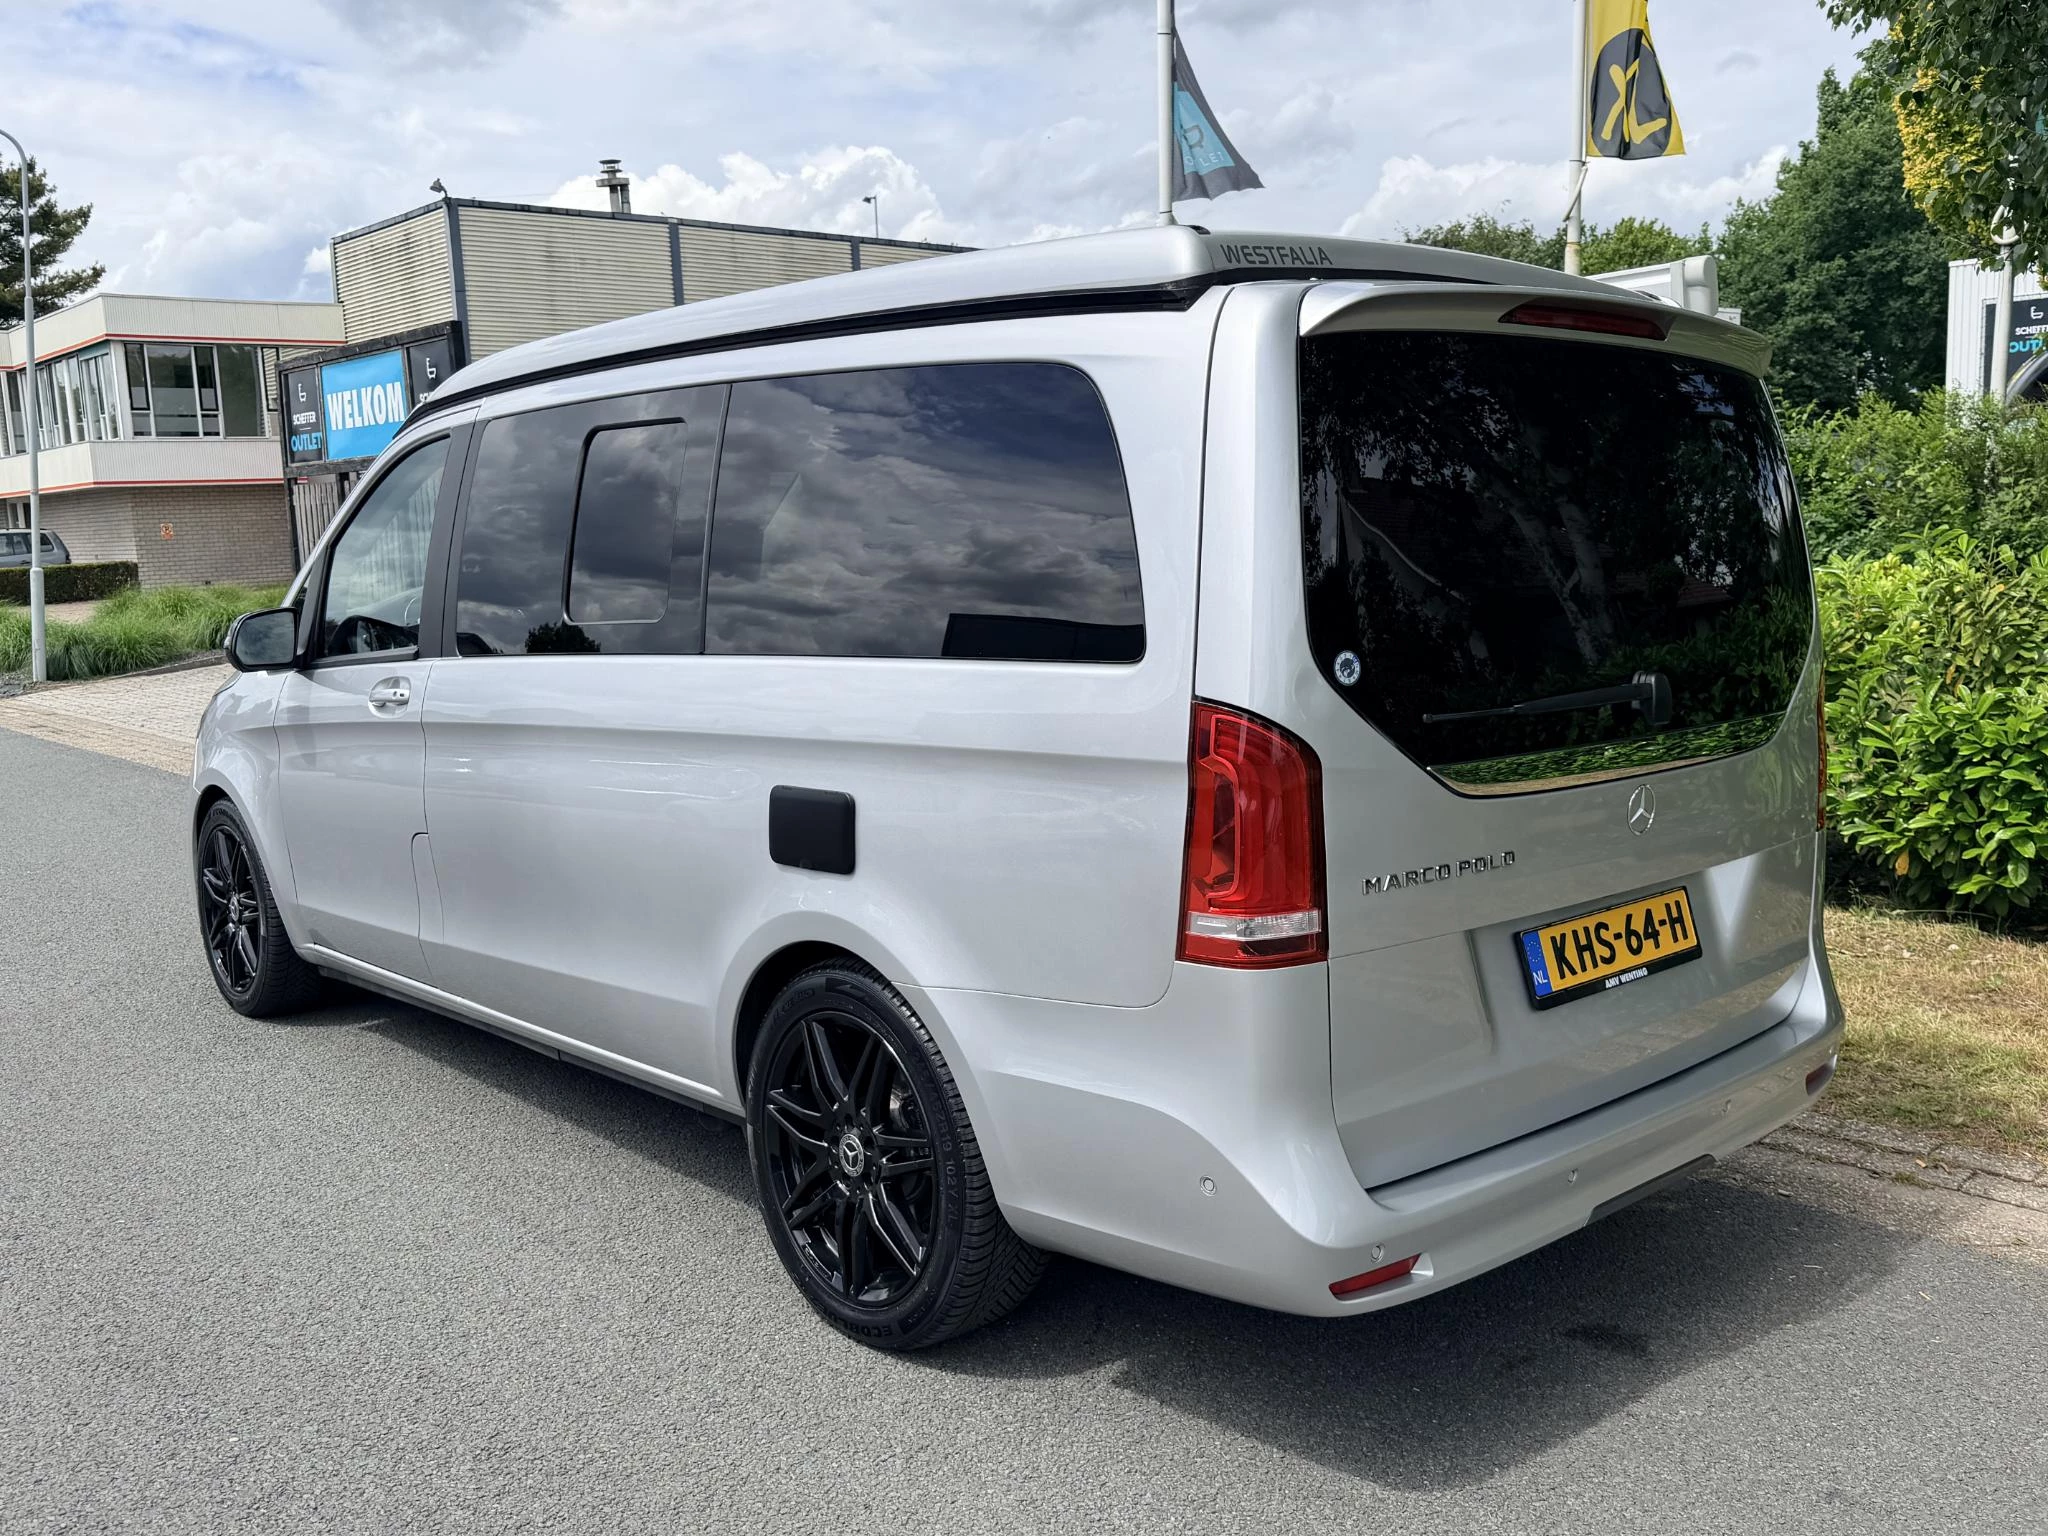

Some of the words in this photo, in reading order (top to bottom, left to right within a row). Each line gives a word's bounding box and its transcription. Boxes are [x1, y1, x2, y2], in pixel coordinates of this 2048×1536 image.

[1220, 244, 1333, 266] WESTFALIA
[327, 381, 405, 431] WELKOM
[291, 432, 322, 452] OUTLET
[1362, 864, 1450, 896] MARCO
[1456, 850, 1515, 878] POLO
[1550, 899, 1689, 980] KHS-64-H
[1532, 971, 1548, 986] NL
[1605, 976, 1620, 989] AMV
[1620, 967, 1649, 983] WENTING
